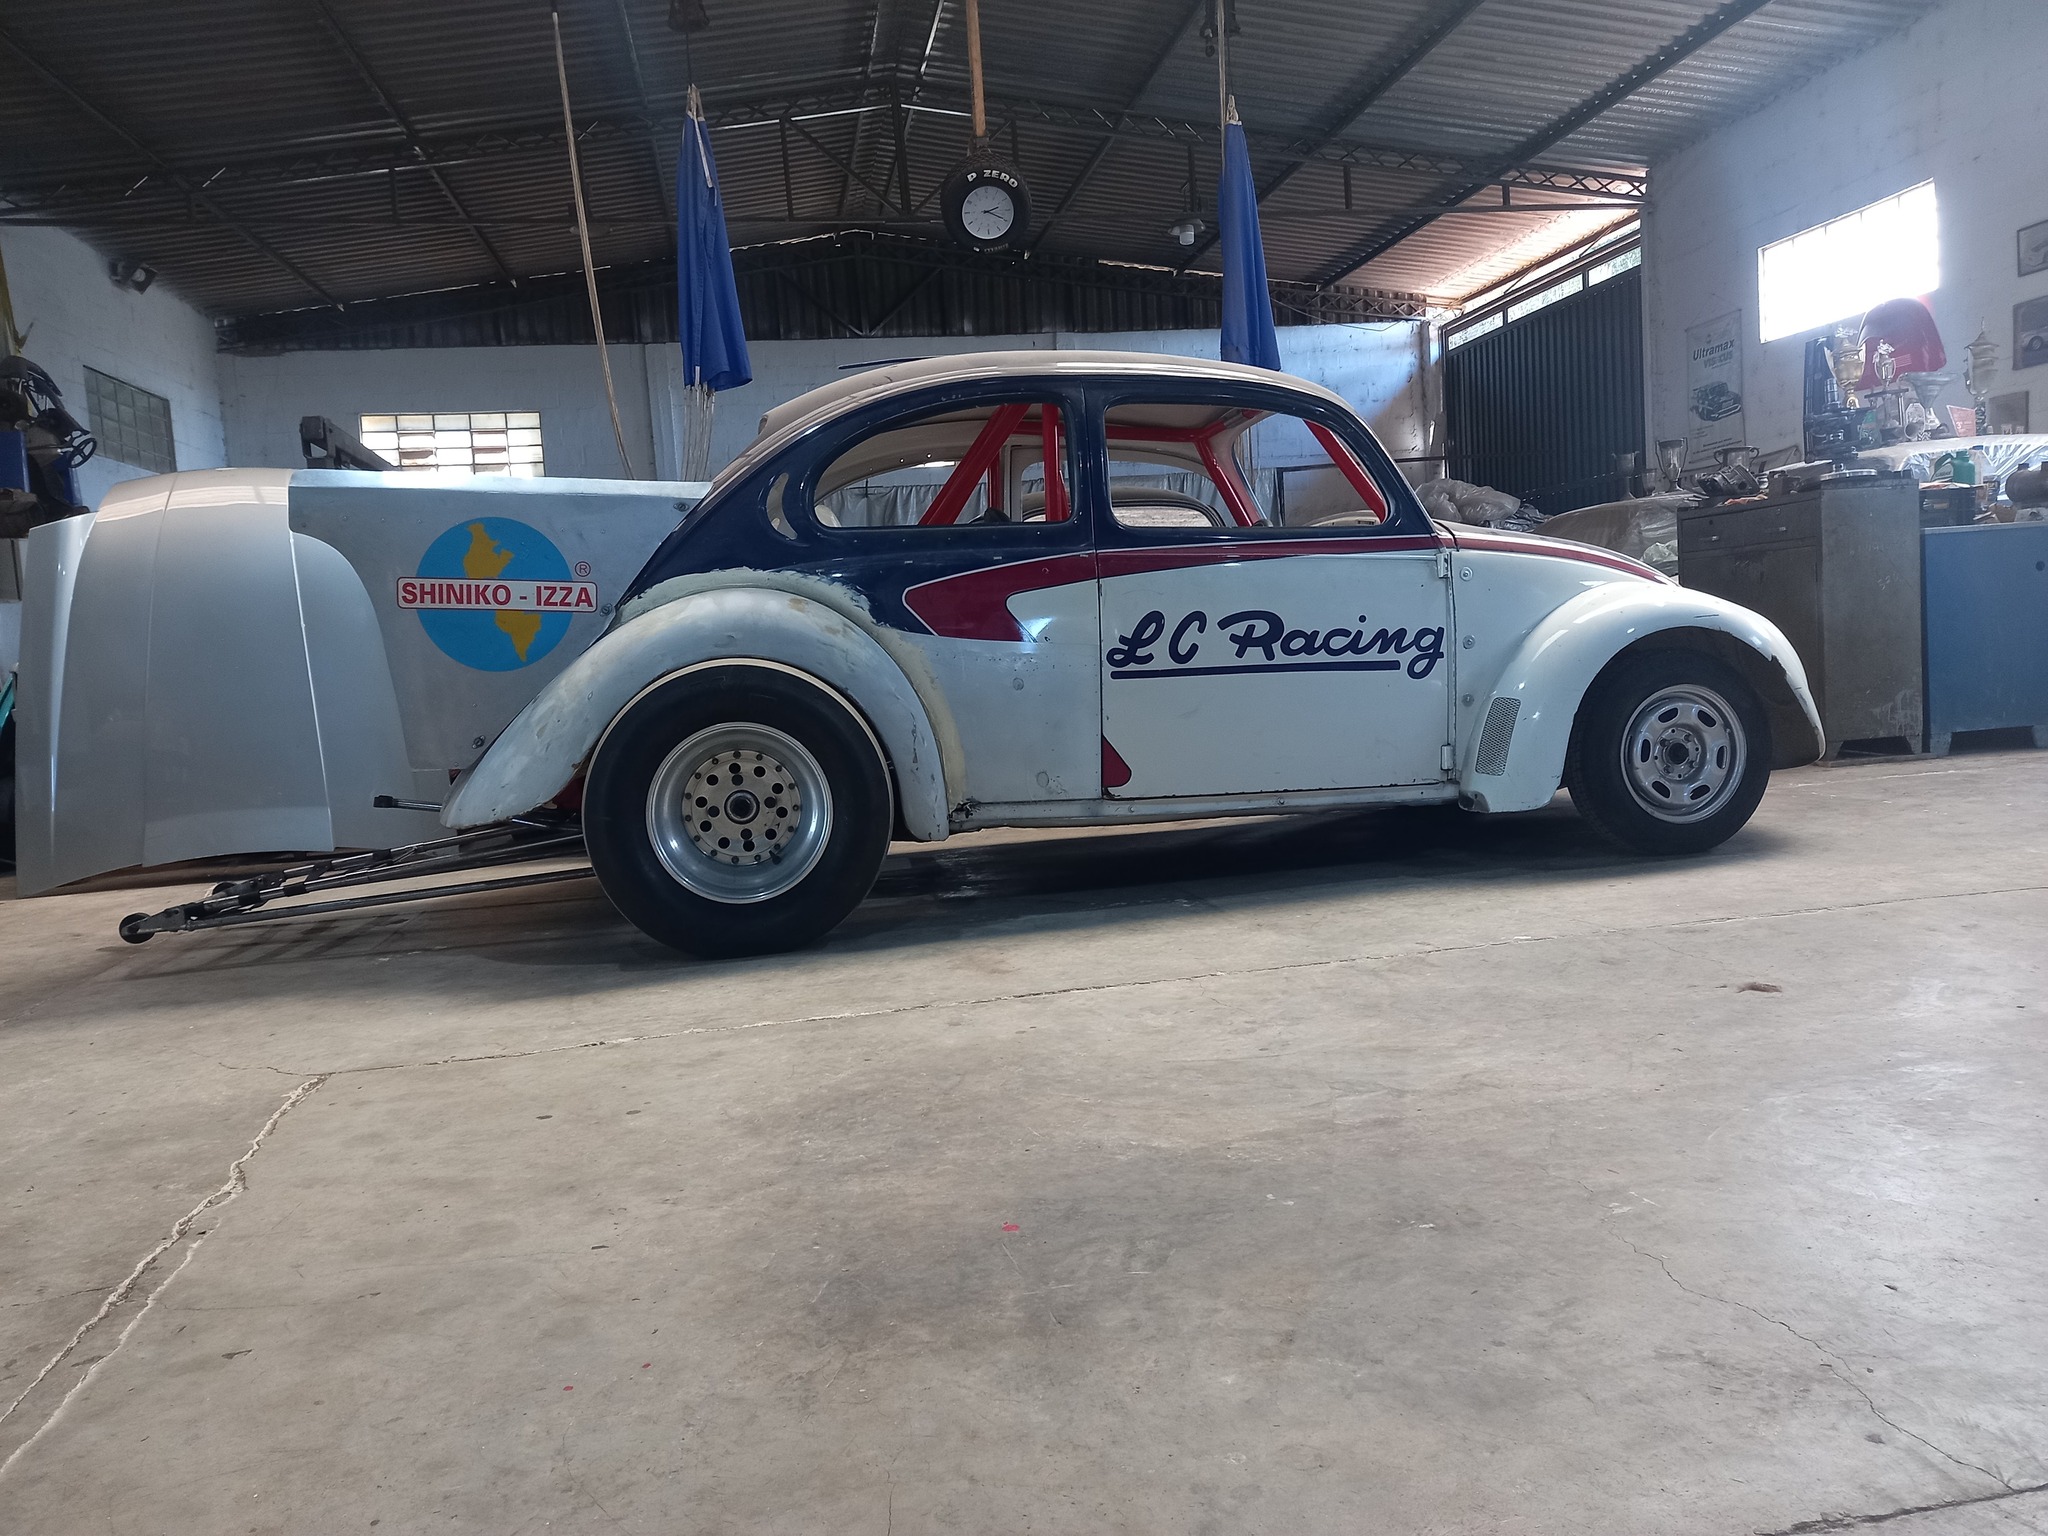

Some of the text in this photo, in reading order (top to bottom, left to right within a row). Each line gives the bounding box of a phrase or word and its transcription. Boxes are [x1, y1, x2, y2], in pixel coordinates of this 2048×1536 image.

[967, 169, 1018, 188] P ZERO
[1693, 339, 1735, 361] Ultramax
[401, 582, 512, 606] SHINIKO
[535, 585, 594, 608] IZZA
[1217, 610, 1445, 680] Racing
